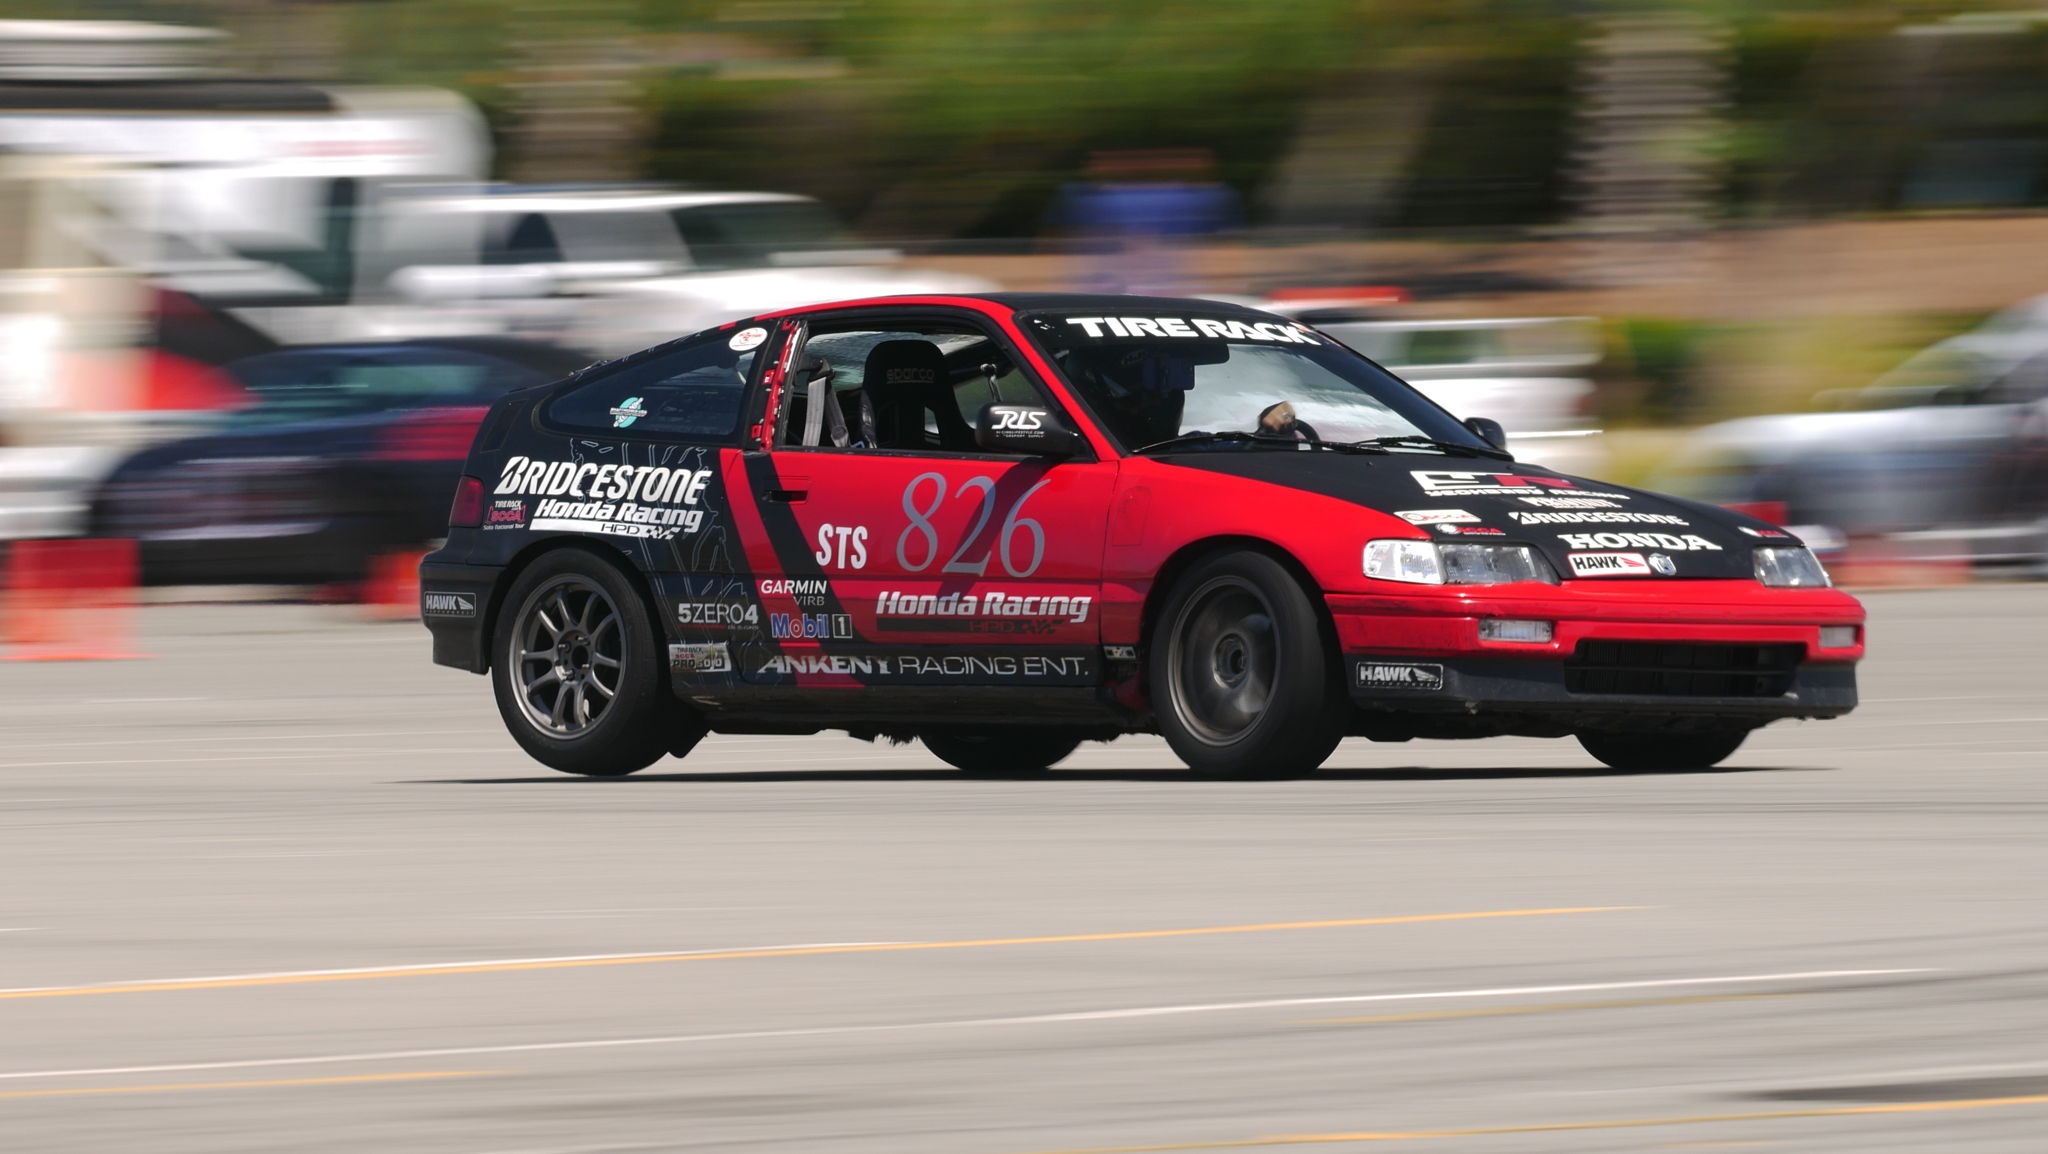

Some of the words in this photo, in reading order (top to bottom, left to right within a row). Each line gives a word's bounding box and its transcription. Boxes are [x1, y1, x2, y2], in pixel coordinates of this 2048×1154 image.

[1066, 317, 1199, 338] TIRE
[1191, 318, 1321, 346] RACK
[494, 456, 712, 505] BRIDGESTONE
[534, 499, 612, 522] Honda
[615, 502, 704, 533] Racing
[896, 472, 1051, 578] 826
[1508, 511, 1690, 526] BRIDGESTONE
[600, 523, 640, 535] HPD
[816, 523, 868, 569] STS
[1557, 533, 1723, 551] HONDA
[1574, 556, 1622, 570] HAWK
[760, 580, 827, 594] GARMIN
[426, 594, 457, 610] HAWK
[793, 596, 825, 606] VIRB
[876, 591, 979, 616] Honda
[982, 592, 1092, 623] Racing
[678, 602, 759, 624] 5ZERO4
[771, 613, 829, 638] Mobil
[757, 655, 892, 674] ANKENY
[899, 656, 1017, 675] RACING
[1024, 656, 1089, 676] ENT.
[1360, 666, 1412, 682] HAWK
